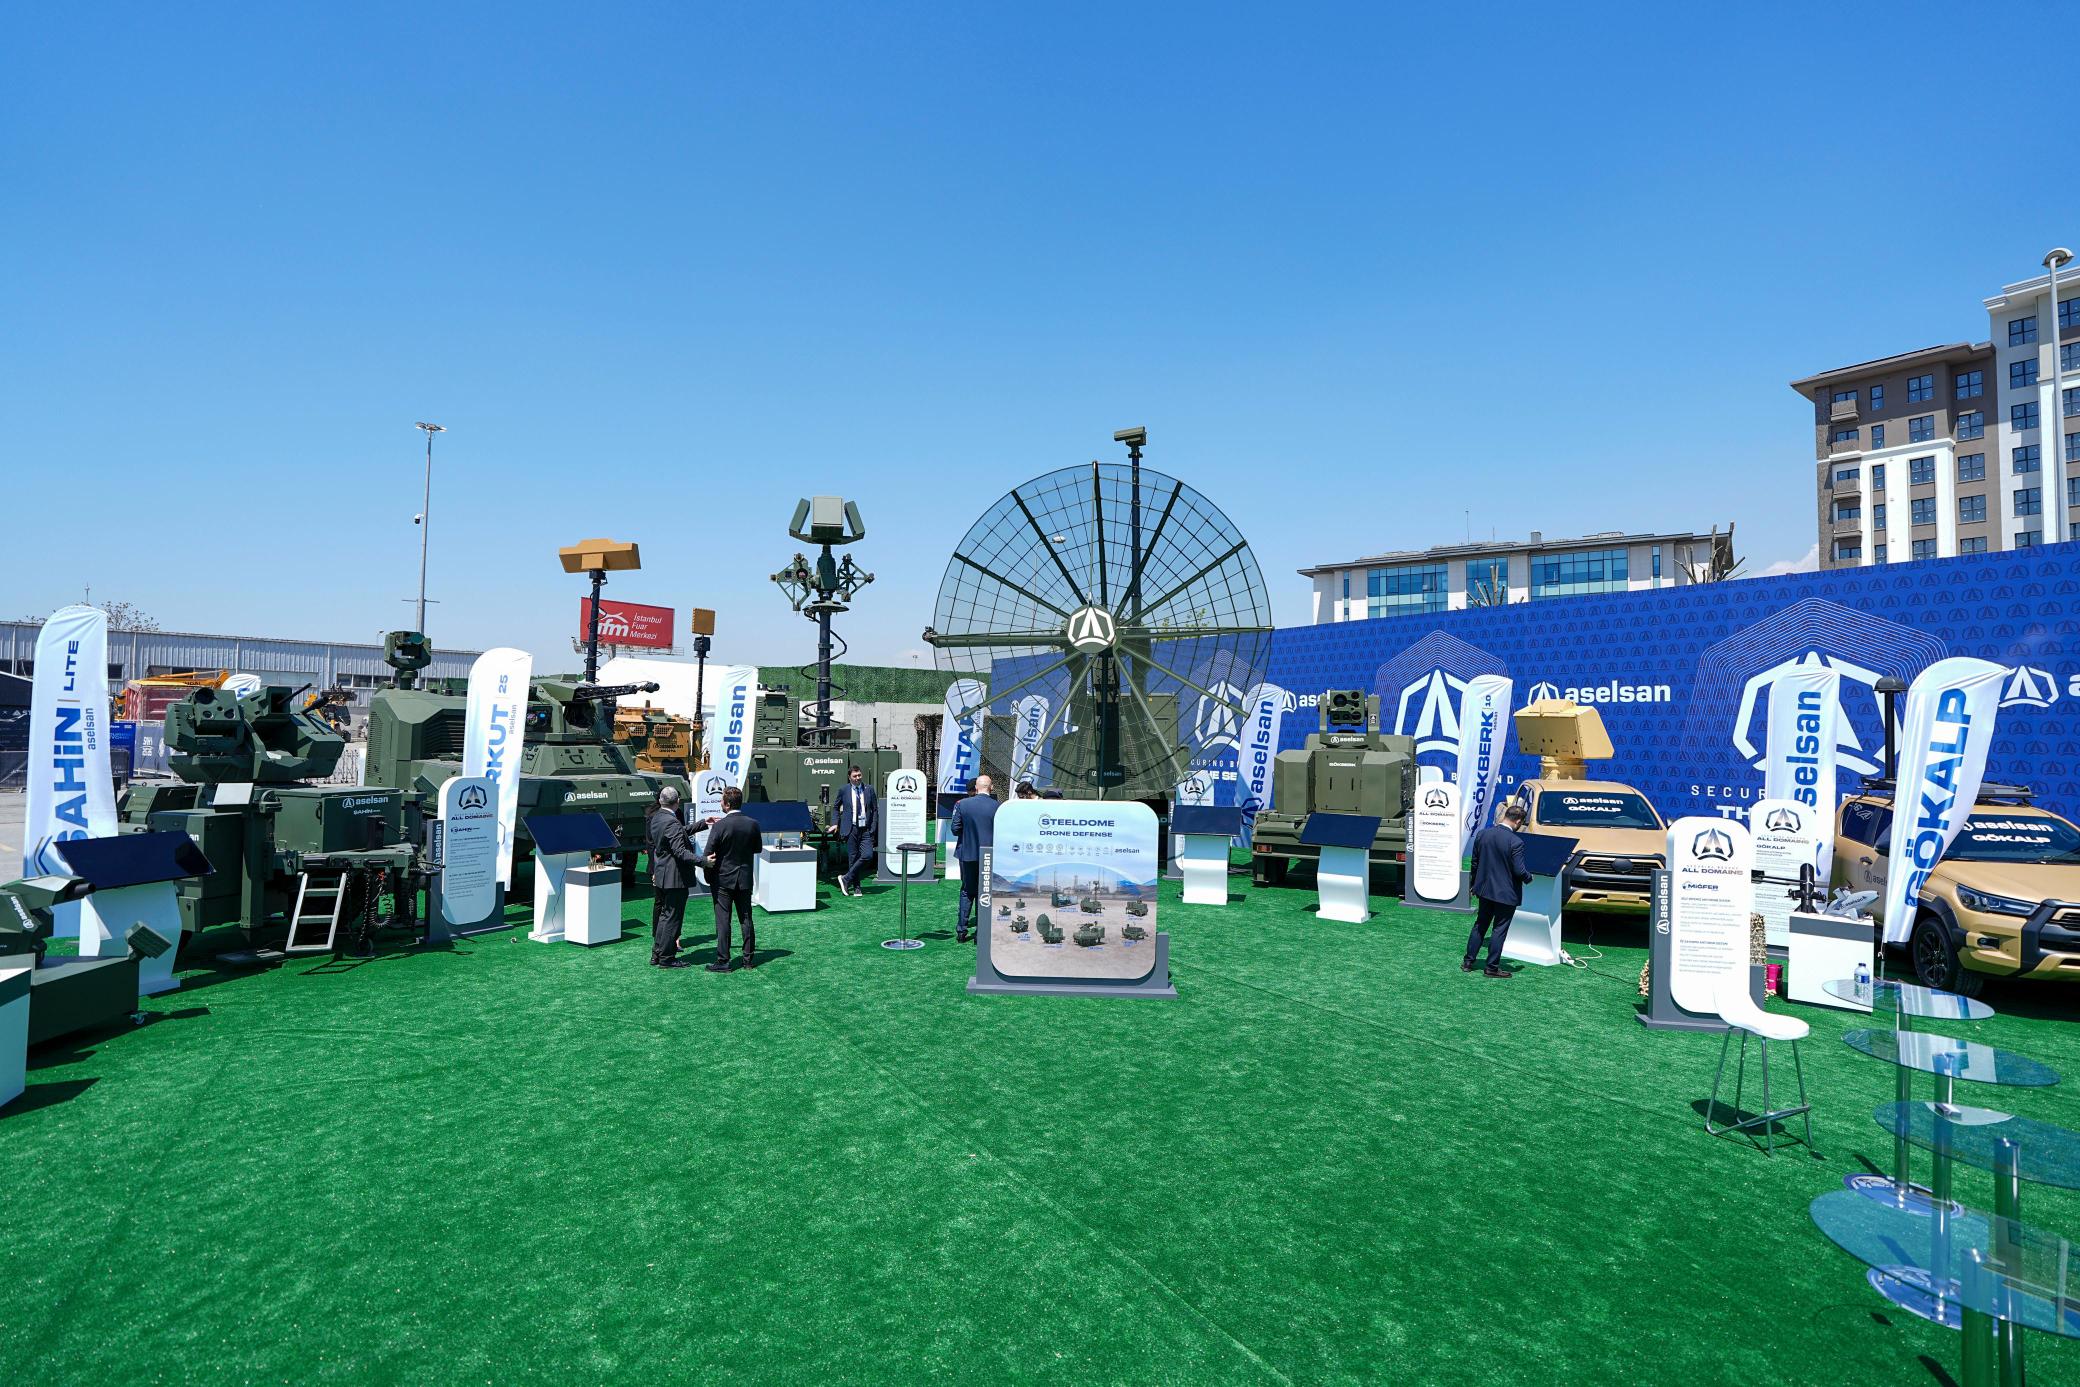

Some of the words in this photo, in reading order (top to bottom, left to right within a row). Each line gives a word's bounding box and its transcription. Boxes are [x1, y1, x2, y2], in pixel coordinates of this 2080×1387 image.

[629, 631, 657, 640] Merkezi
[631, 621, 648, 630] Fuar
[64, 640, 79, 691] LITE
[499, 674, 508, 694] 25
[1565, 680, 1671, 702] aselsan
[84, 707, 96, 750] aselsan
[723, 685, 747, 777] selsan
[1250, 700, 1274, 794] aselsan
[1786, 691, 1822, 808] selsan
[355, 795, 389, 805] aselsan
[577, 790, 609, 799] aselsan
[1579, 797, 1624, 805] aselsan
[1905, 687, 1973, 906] GÖKALP
[1041, 818, 1115, 827] STEELDOME
[1973, 820, 2053, 832] aselsan
[434, 824, 442, 858] aselsan
[1972, 834, 2051, 843] GÖKALP
[981, 853, 991, 892] aselsan
[1658, 875, 1669, 918] aselsan
